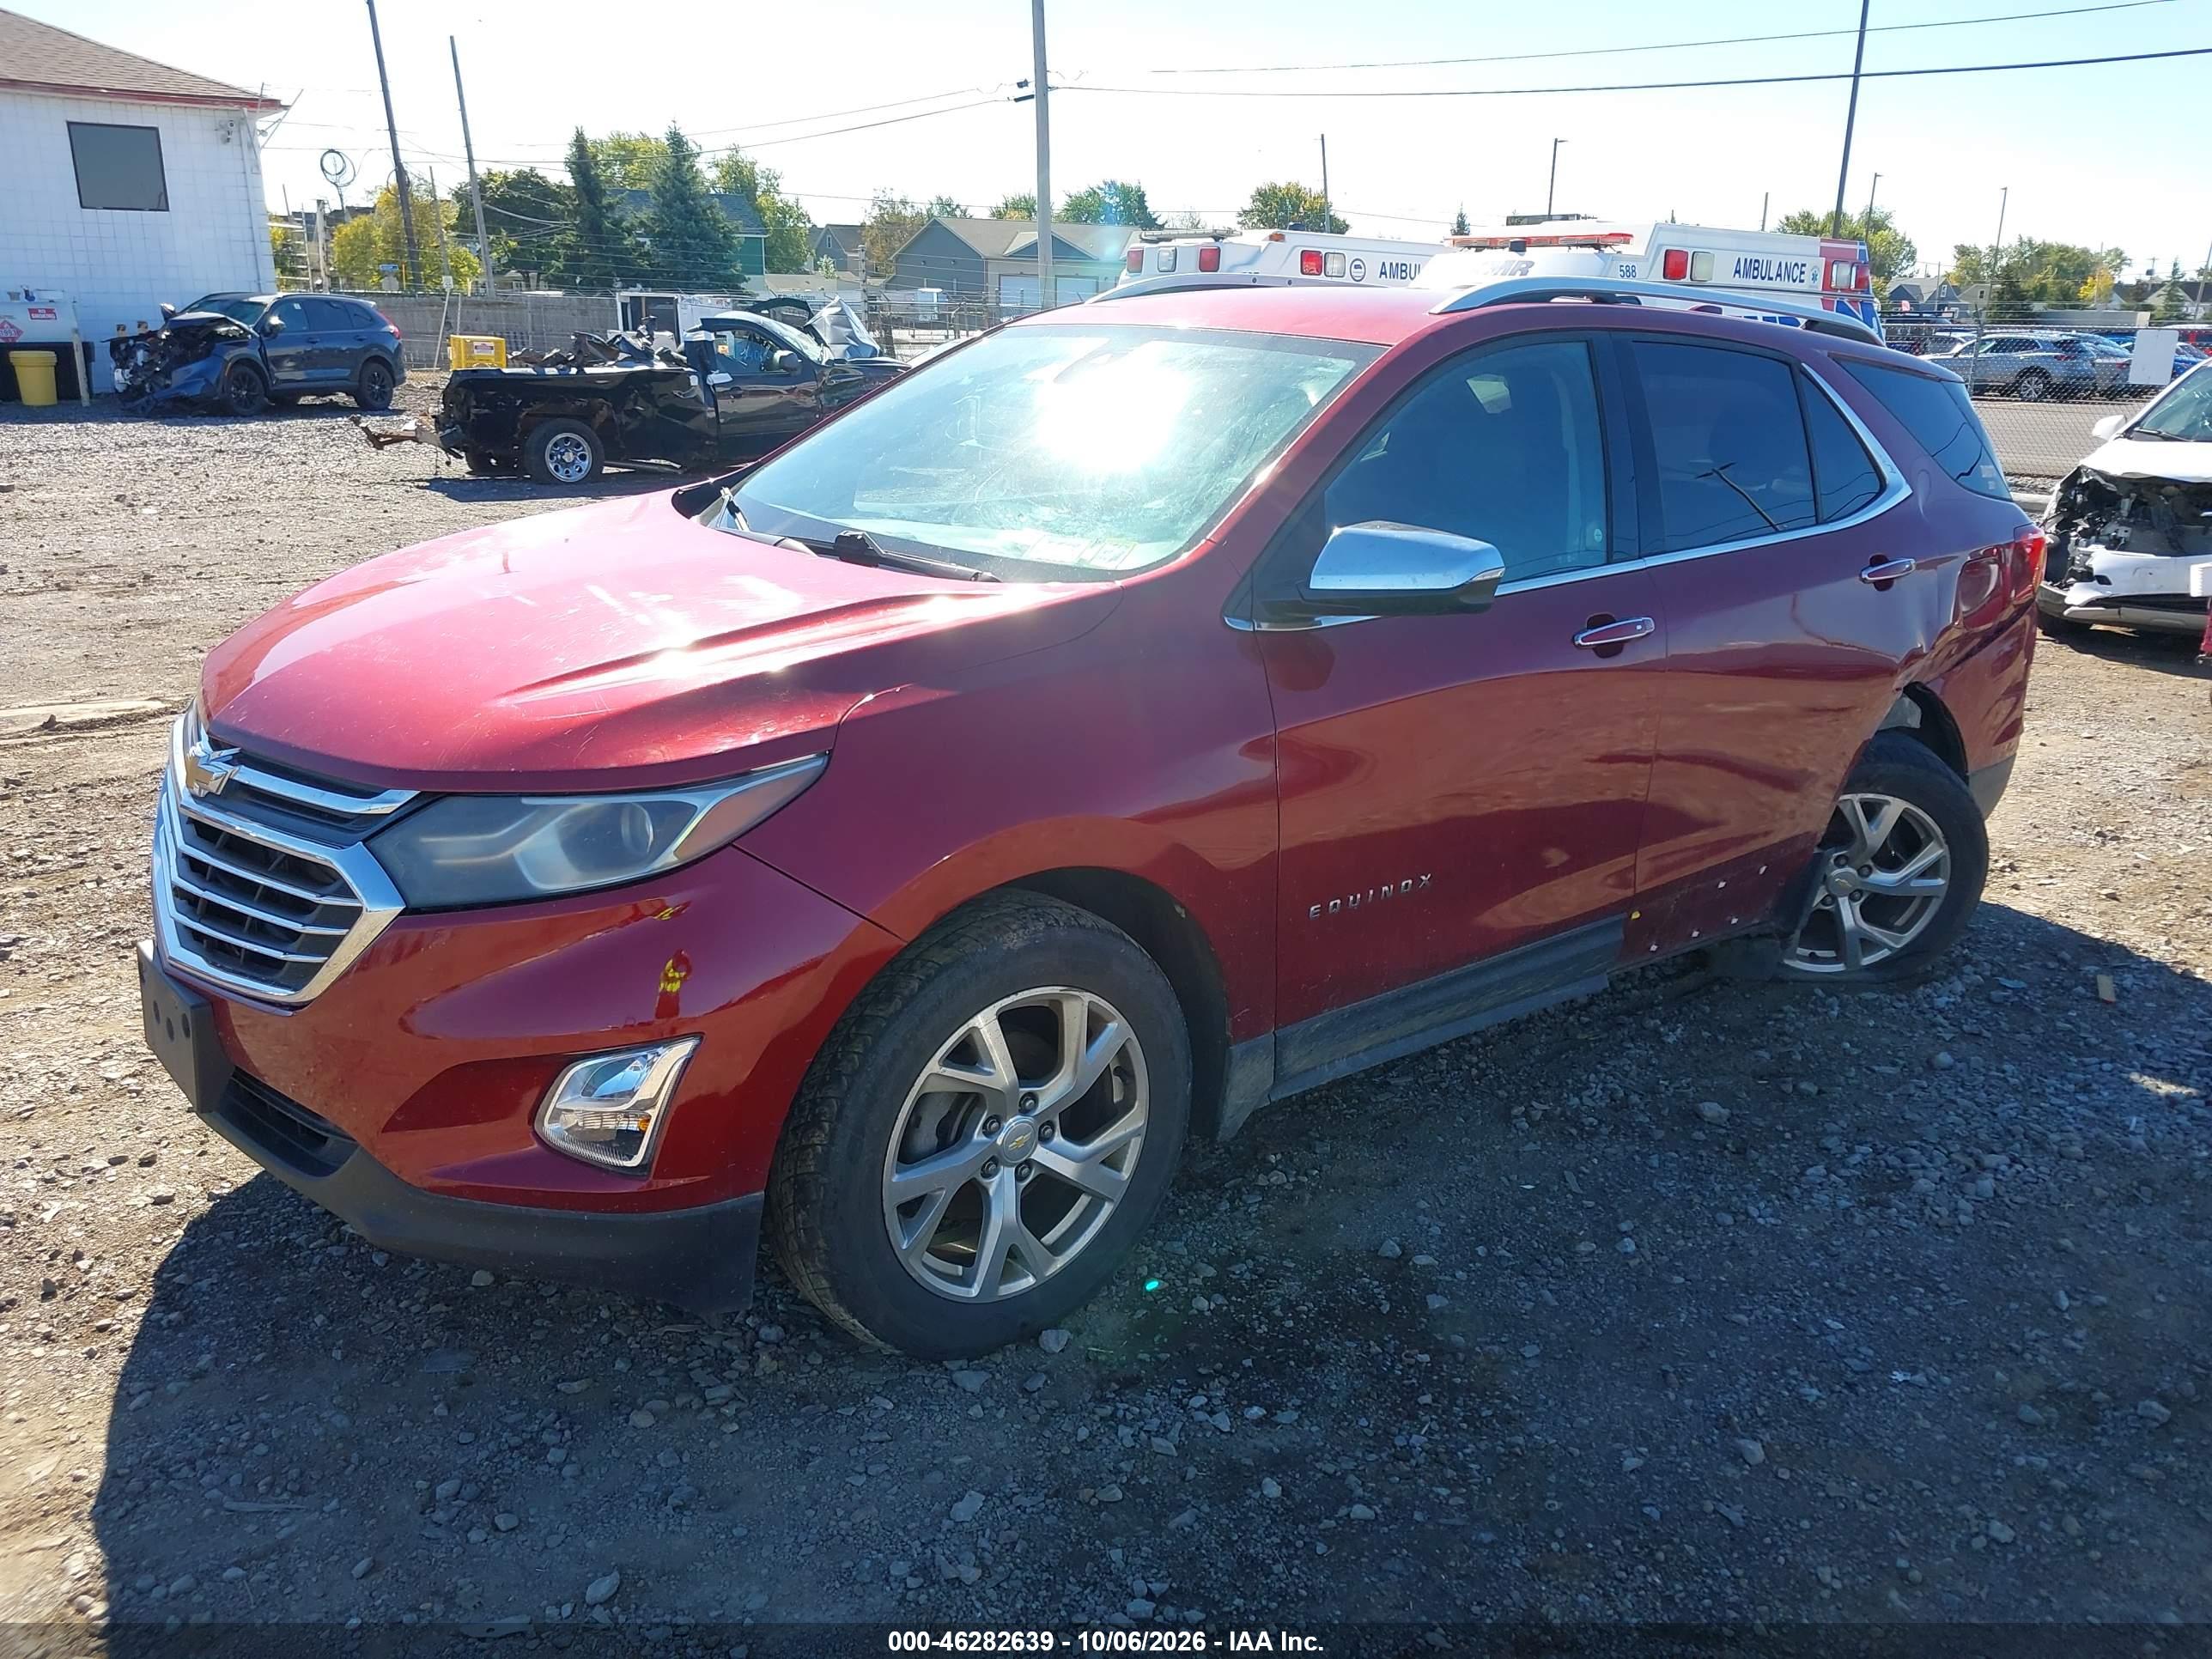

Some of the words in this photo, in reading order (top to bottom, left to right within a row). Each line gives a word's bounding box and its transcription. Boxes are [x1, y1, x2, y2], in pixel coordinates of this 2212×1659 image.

[1619, 264, 1637, 278] 588
[1733, 258, 1807, 283] AMBULANCE
[1310, 872, 1431, 921] EQUINOX
